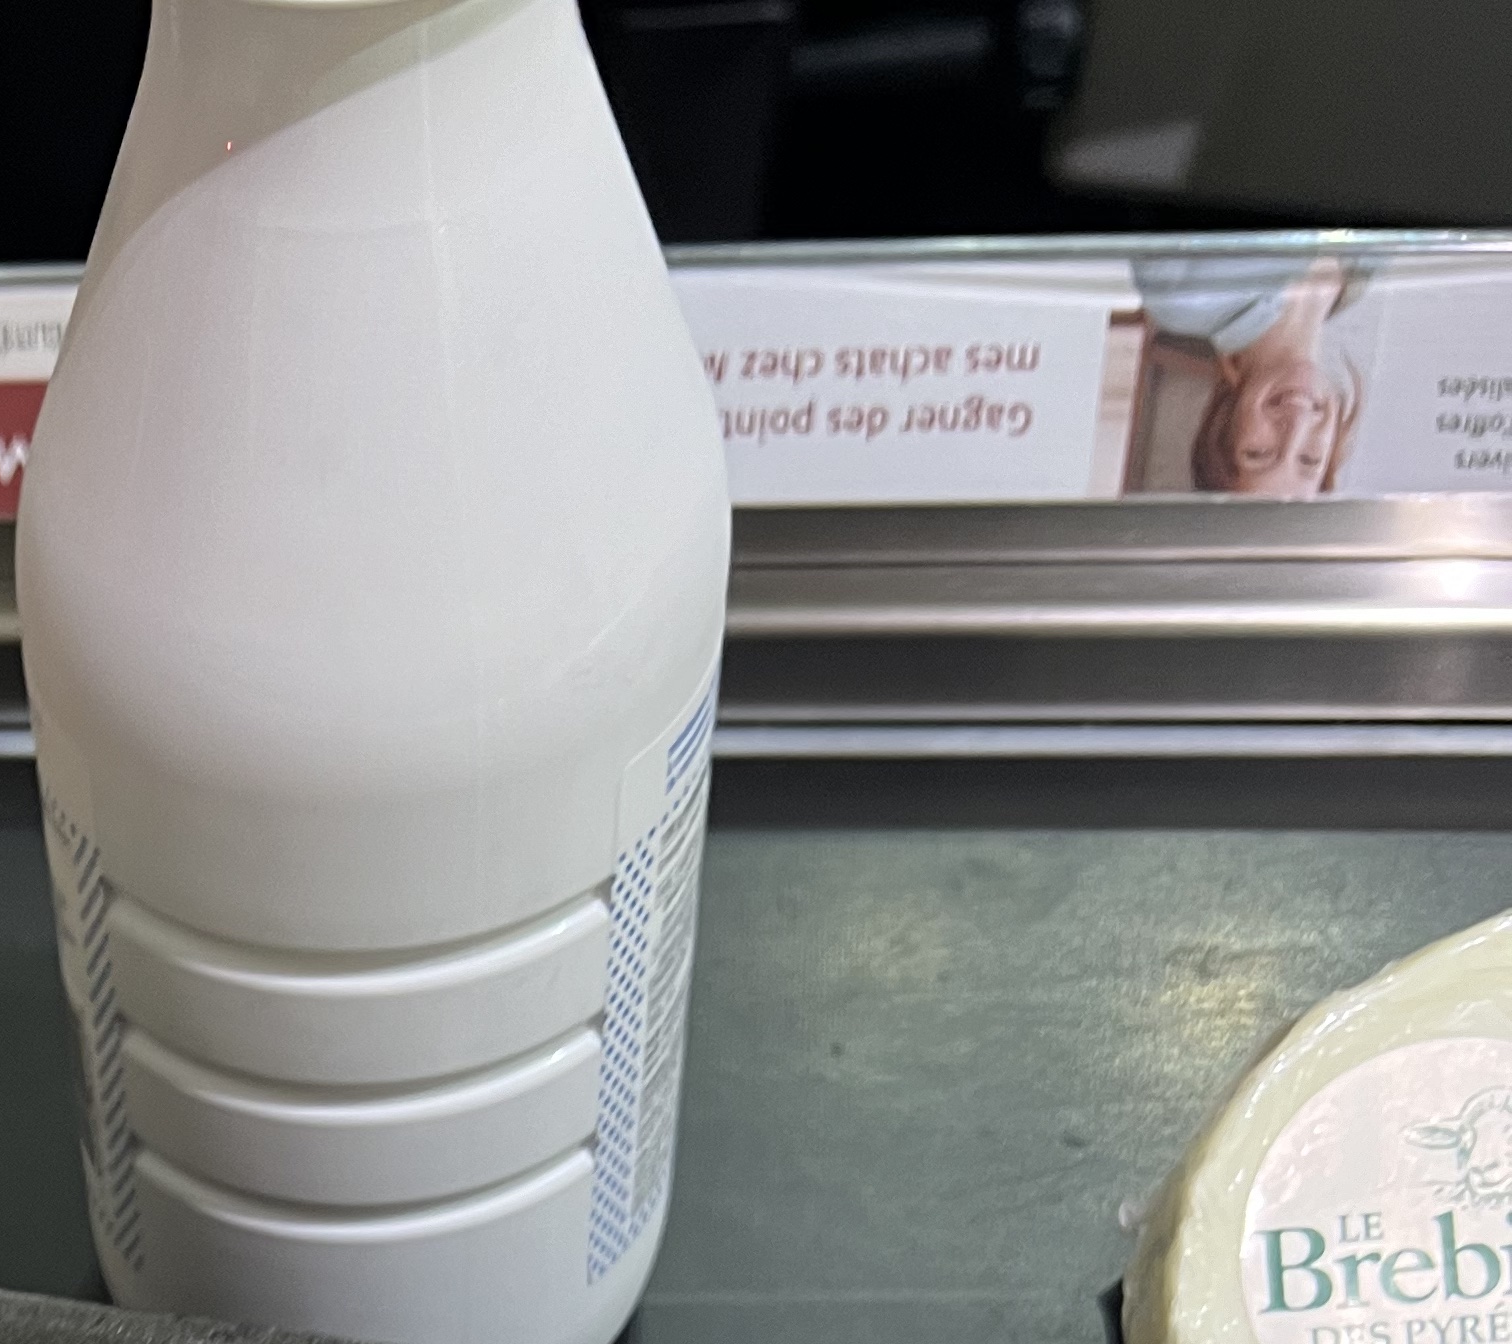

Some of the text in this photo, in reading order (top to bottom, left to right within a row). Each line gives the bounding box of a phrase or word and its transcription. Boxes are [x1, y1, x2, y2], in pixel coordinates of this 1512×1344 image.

[739, 346, 826, 387] chez
[834, 342, 955, 387] achats
[965, 342, 1042, 373] mes
[722, 394, 1034, 444] Gagner des point
[1337, 1211, 1385, 1244] LE
